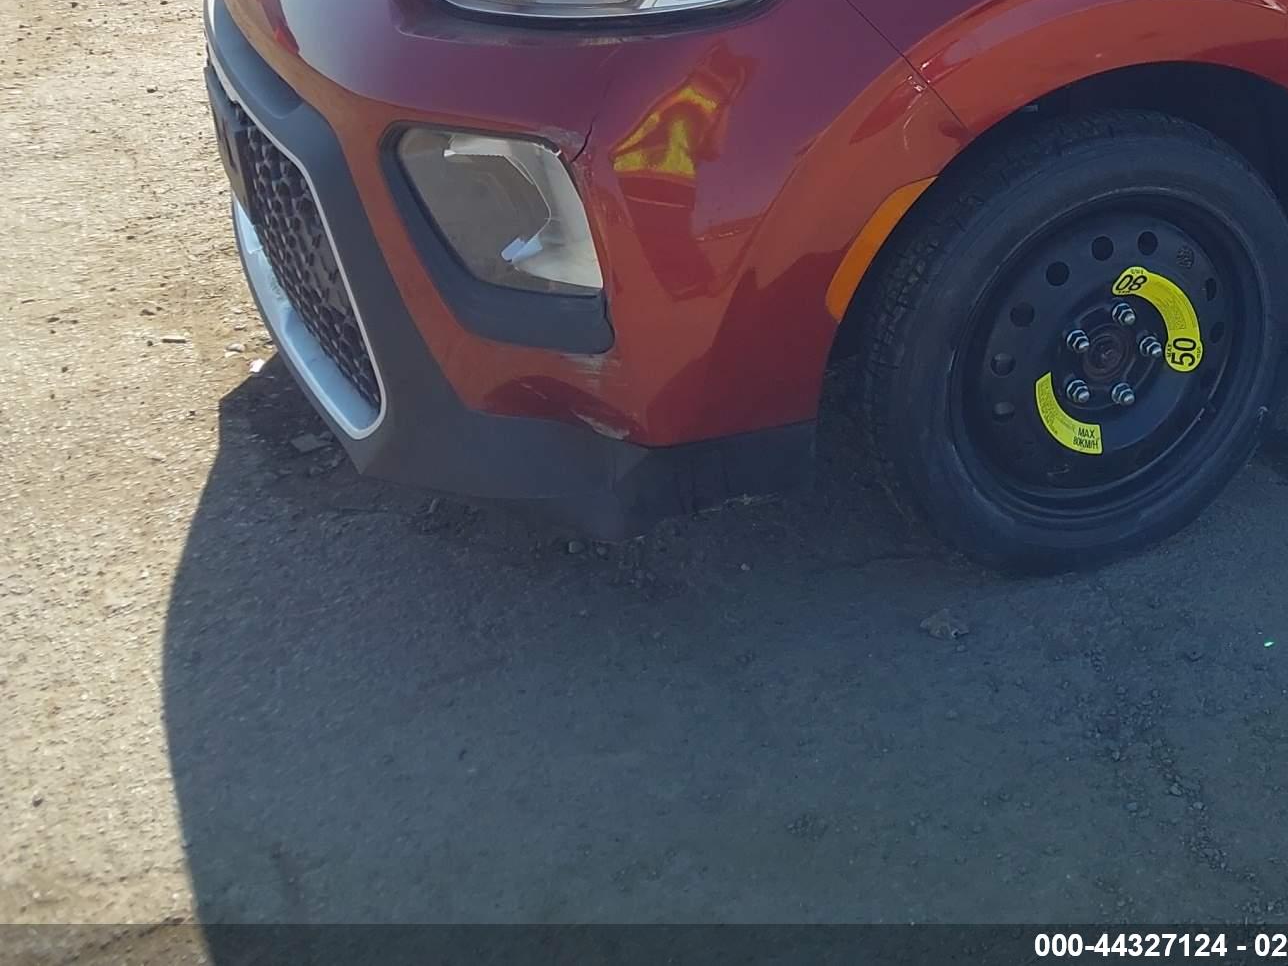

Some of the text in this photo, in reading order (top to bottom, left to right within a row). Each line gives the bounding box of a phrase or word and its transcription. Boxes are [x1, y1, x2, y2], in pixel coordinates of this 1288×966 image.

[1115, 274, 1147, 291] 80
[1170, 337, 1196, 367] 50
[1077, 427, 1095, 439] MAX
[1073, 436, 1099, 450] 80KM/H
